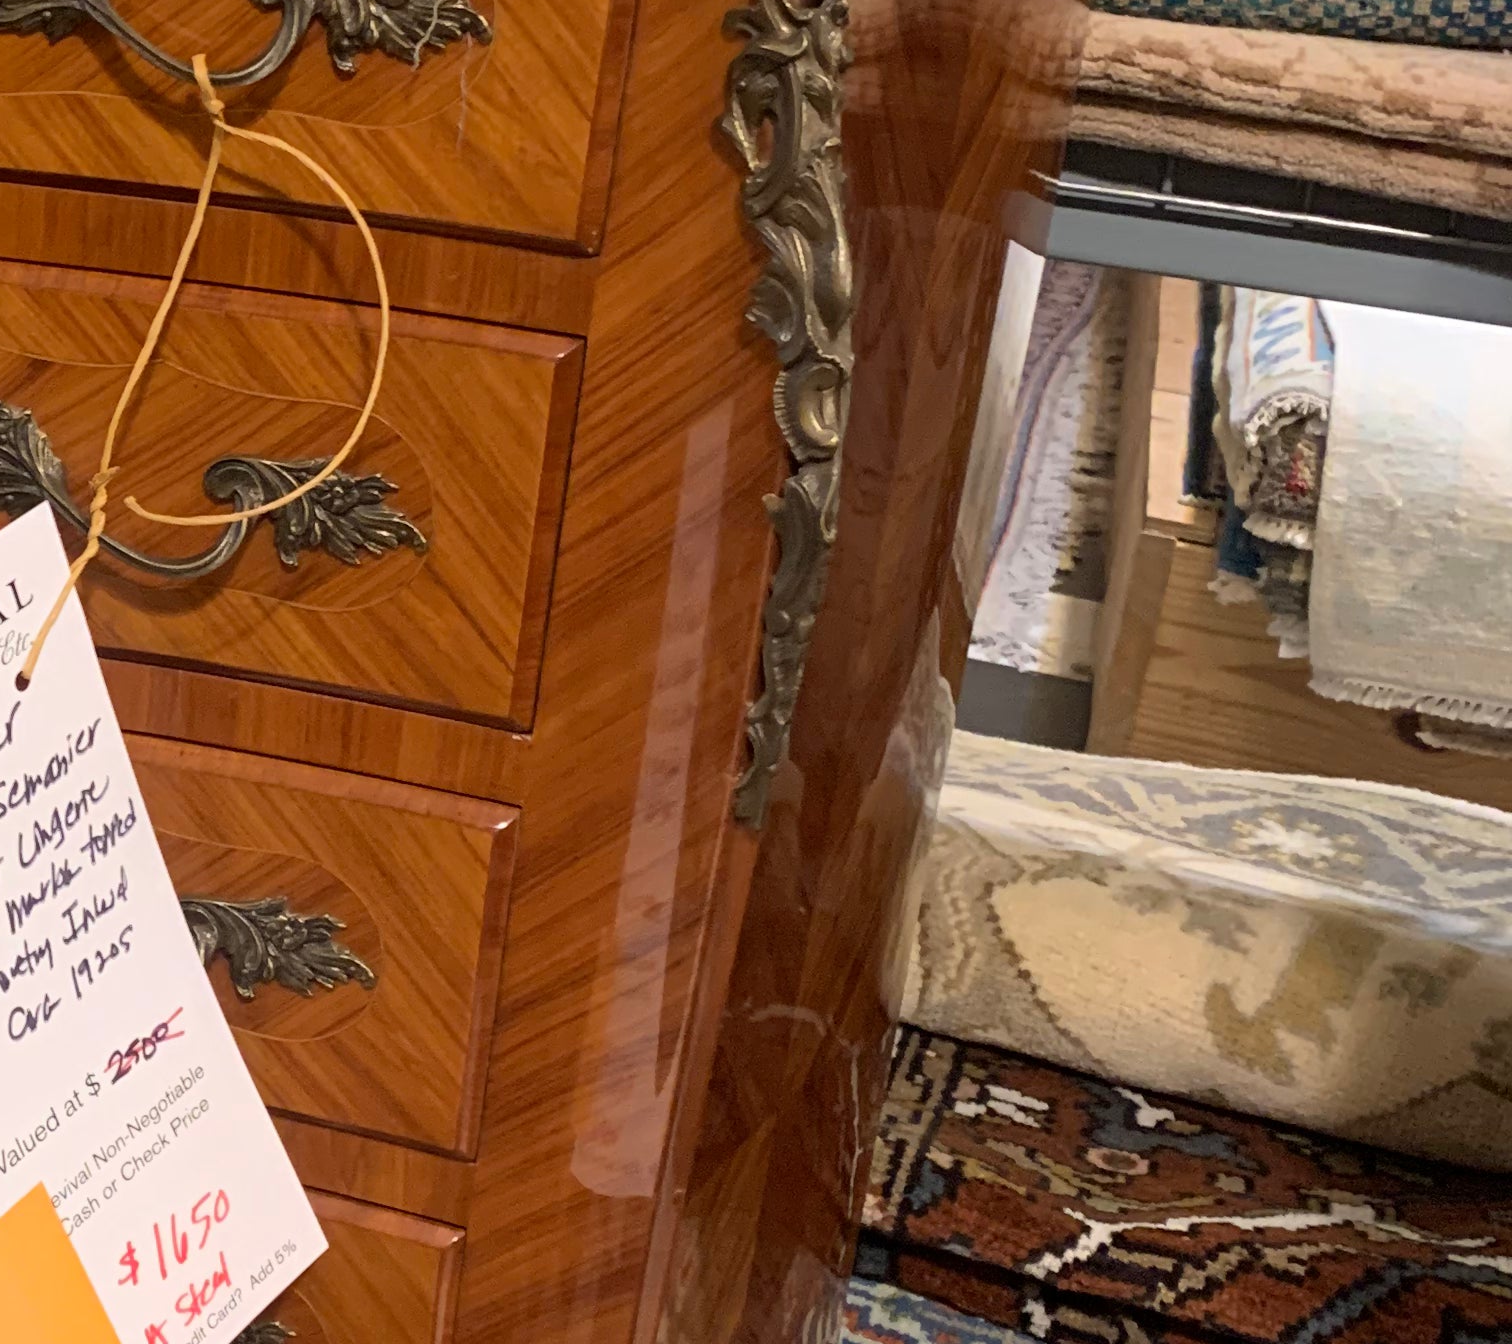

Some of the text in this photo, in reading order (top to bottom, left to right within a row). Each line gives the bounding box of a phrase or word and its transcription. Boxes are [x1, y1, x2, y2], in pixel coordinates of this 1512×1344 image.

[50, 1064, 205, 1209] evival Non-Negotiable
[64, 1090, 84, 1117] at
[61, 1098, 209, 1236] Cash or Check Price
[206, 1288, 242, 1329] Card?
[250, 1264, 274, 1290] Add
[274, 1239, 297, 1264] 5%
